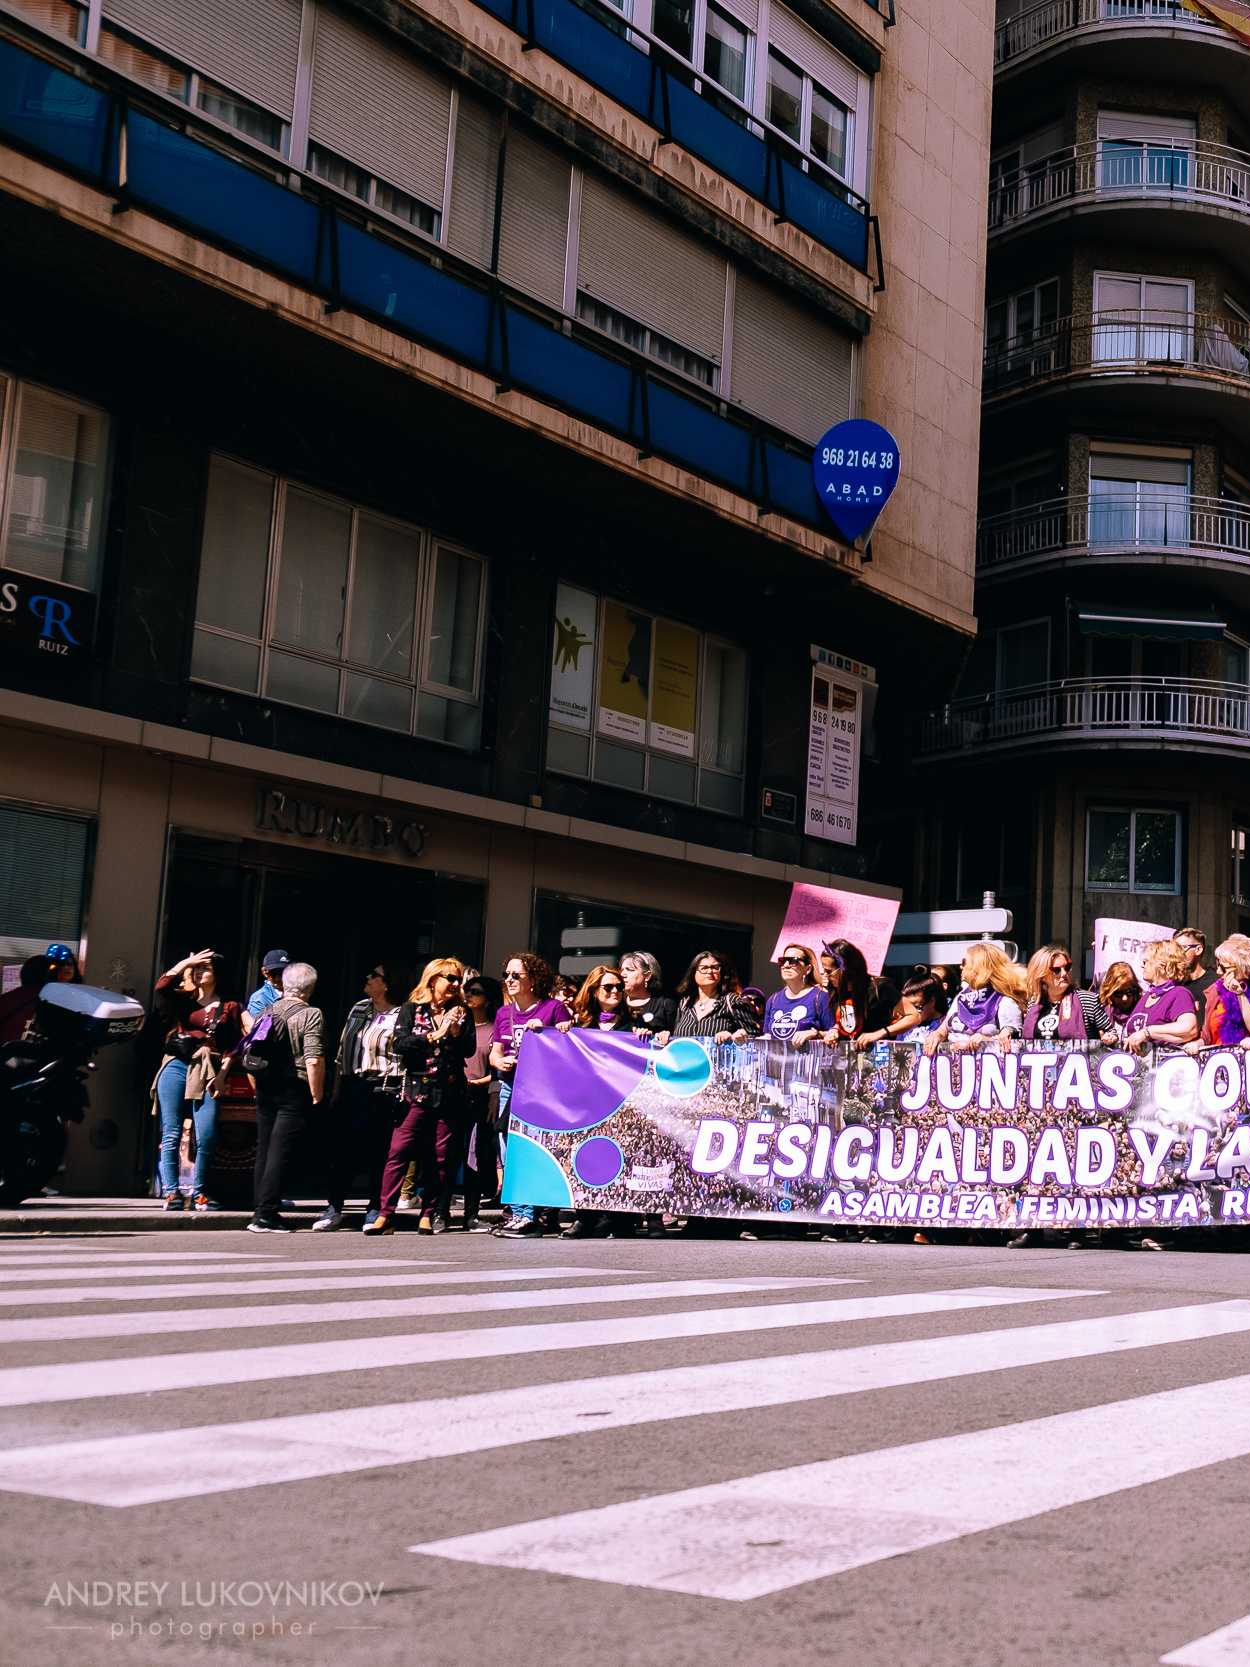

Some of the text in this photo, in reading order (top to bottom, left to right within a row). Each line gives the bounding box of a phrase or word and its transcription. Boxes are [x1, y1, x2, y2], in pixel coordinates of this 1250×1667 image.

[822, 447, 893, 469] 968 21 64 38
[826, 482, 883, 496] ABAD
[38, 639, 69, 656] RUIZ
[813, 710, 827, 725] 968
[831, 716, 839, 729] 24
[840, 719, 846, 731] 19
[847, 721, 855, 734] 80
[811, 808, 851, 830] 686 461670
[901, 1051, 1139, 1113] JUNTAS
[690, 1117, 1118, 1187] DESIGUALDAD
[1129, 1125, 1176, 1187] Y
[820, 1189, 998, 1222] ASAMBLEA
[1018, 1190, 1200, 1222] FEMINISTA
